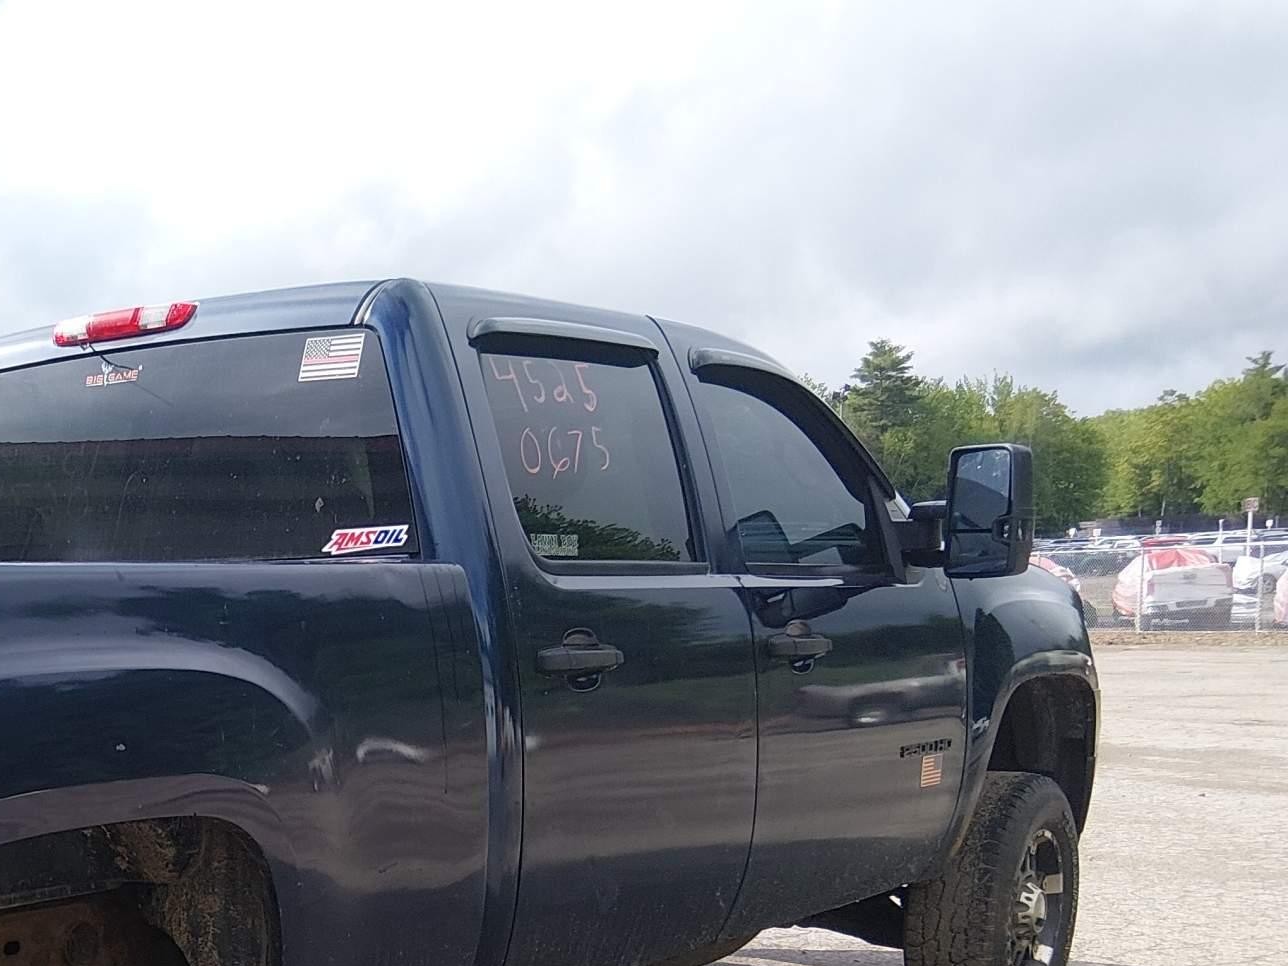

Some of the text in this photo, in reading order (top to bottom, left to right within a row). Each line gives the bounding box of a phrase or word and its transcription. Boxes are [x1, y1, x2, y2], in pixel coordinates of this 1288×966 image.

[85, 369, 139, 386] BIG GAME
[489, 357, 598, 412] 4525
[520, 426, 610, 480] 0675
[327, 528, 405, 552] AMSOIL
